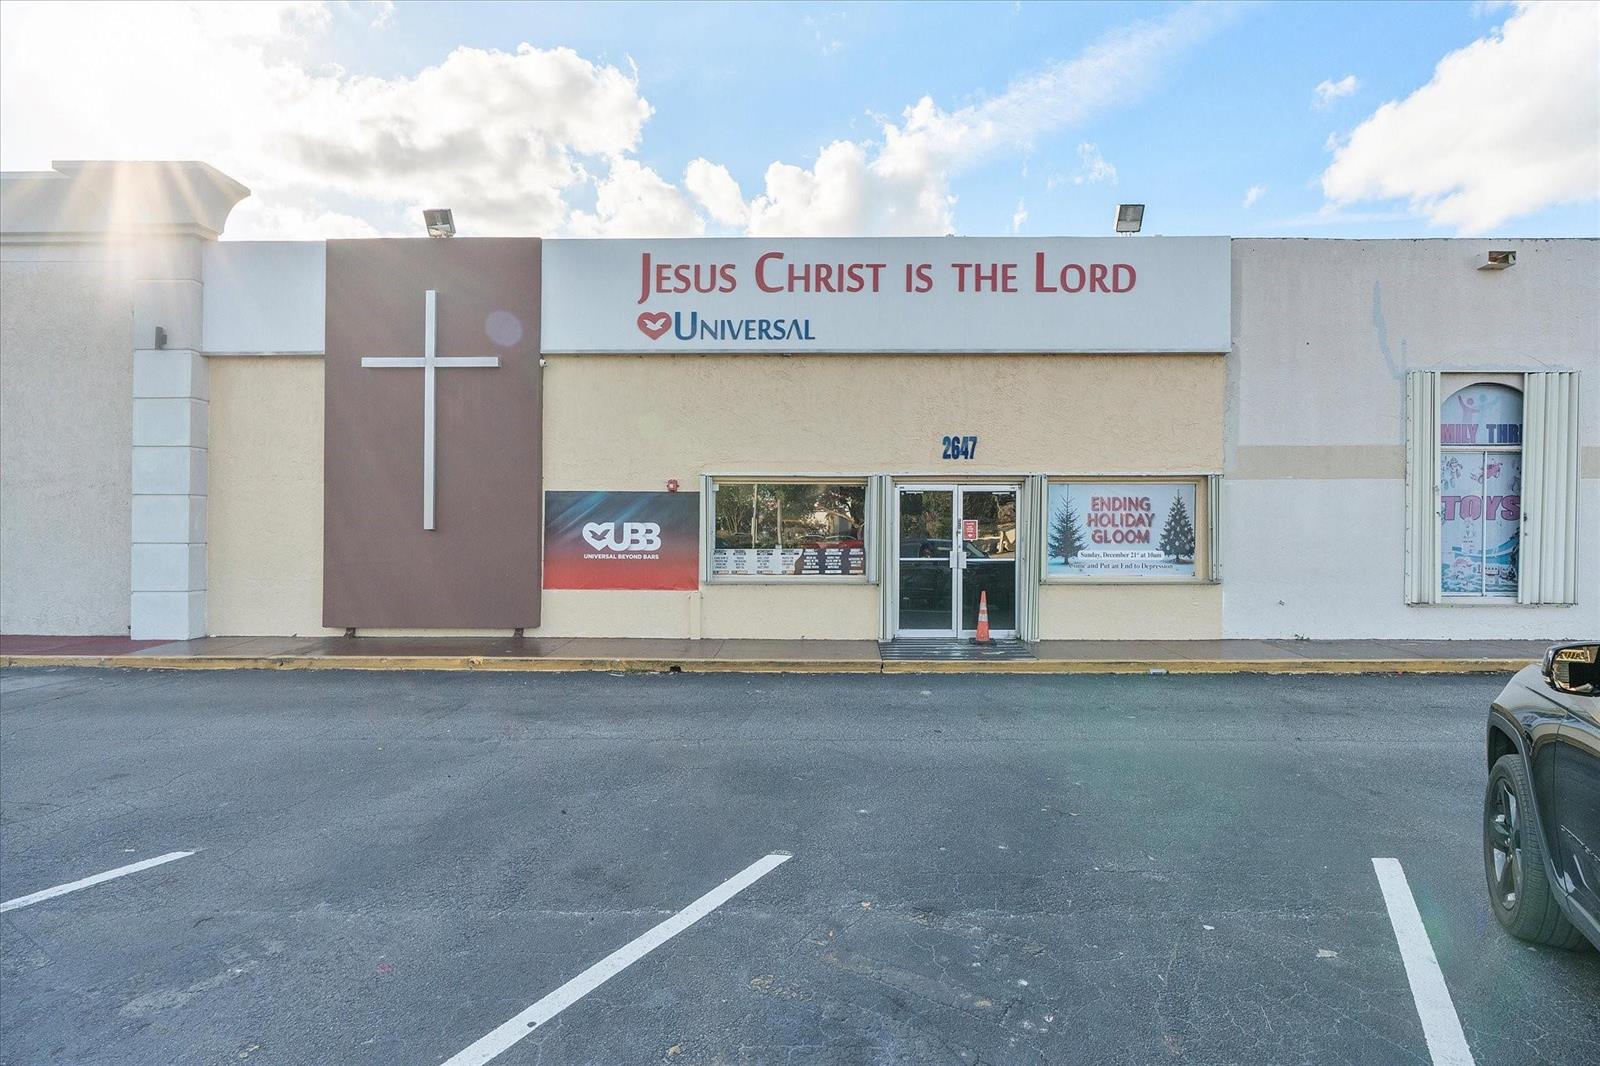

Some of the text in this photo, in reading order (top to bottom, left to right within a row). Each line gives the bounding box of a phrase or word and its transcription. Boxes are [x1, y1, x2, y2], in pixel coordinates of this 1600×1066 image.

[637, 251, 1137, 305] JESUS CHRIST IS THE LORD
[674, 311, 816, 341] UNIVERSAL
[942, 435, 978, 460] 2647
[1090, 496, 1151, 512] ENDING
[1440, 494, 1521, 521] TOYS
[1087, 512, 1156, 528] HOLIDAY
[606, 521, 662, 552] UBB
[1091, 529, 1151, 545] GLOOM
[1080, 551, 1102, 559] Sunday,
[1141, 562, 1174, 570] Depression
